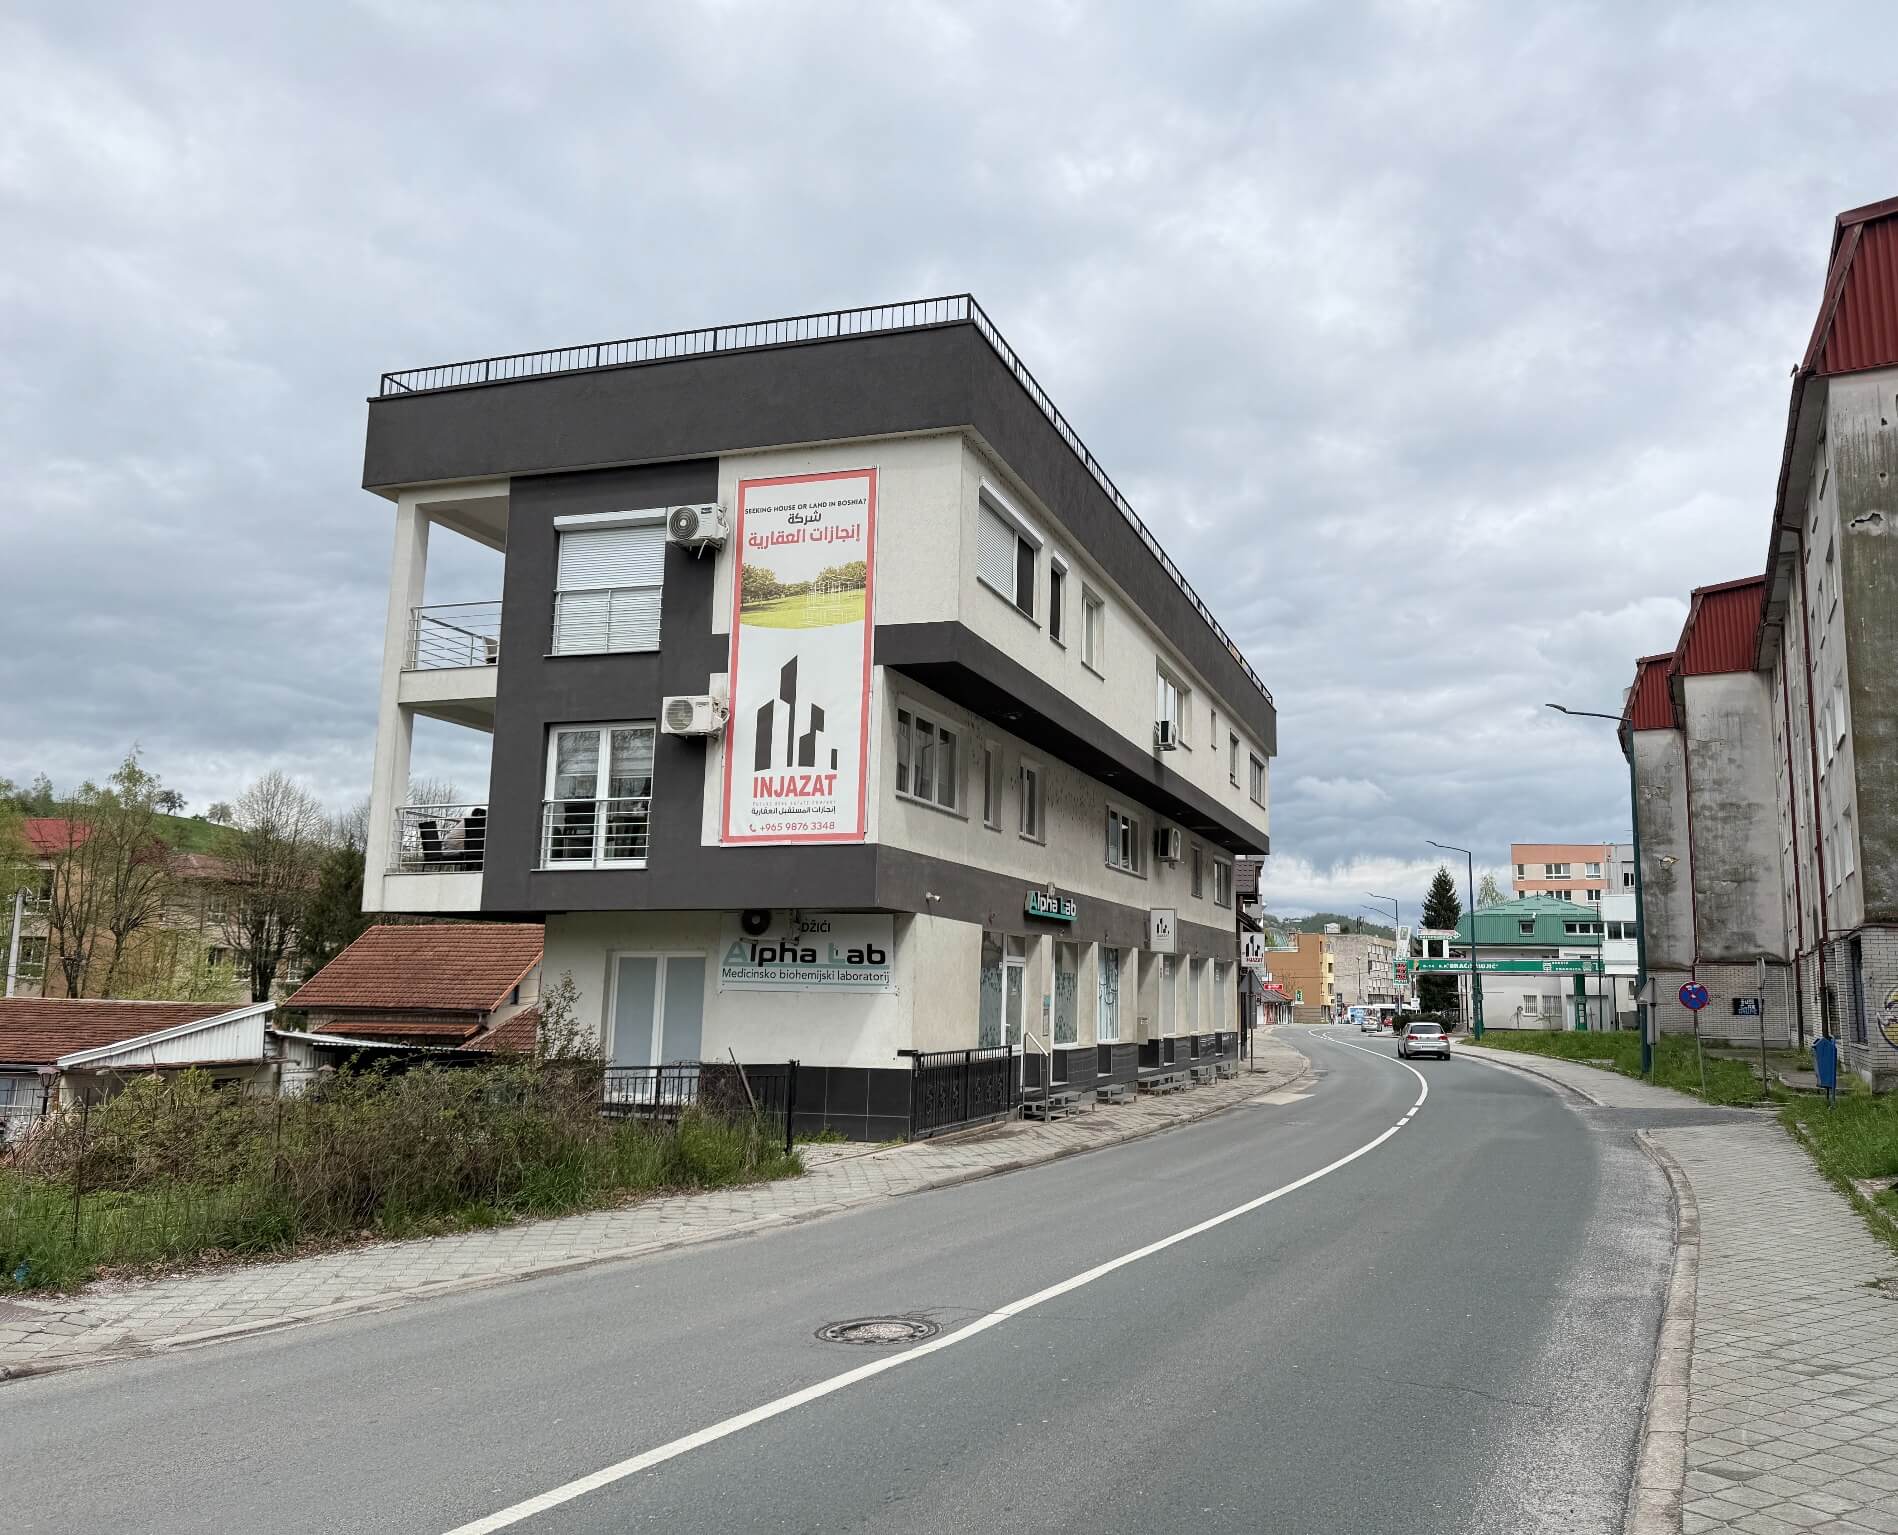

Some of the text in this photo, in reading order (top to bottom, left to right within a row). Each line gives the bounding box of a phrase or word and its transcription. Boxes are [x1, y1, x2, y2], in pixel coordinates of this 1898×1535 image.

[745, 506, 772, 515] SEEKING
[773, 504, 796, 513] HOUSE
[797, 503, 808, 511] OR
[809, 501, 827, 509] LAND
[787, 510, 822, 526] شركة
[748, 523, 860, 550] إنجازات العقارية
[752, 773, 838, 799] INJAZAT
[759, 821, 835, 832] +965 9876 3348
[1029, 890, 1077, 917] Alpha Lab
[801, 919, 831, 933] DŽIĆI
[722, 940, 886, 967] Alpha Lab
[722, 967, 890, 984] Medicinsko biohemijski laboratorij
